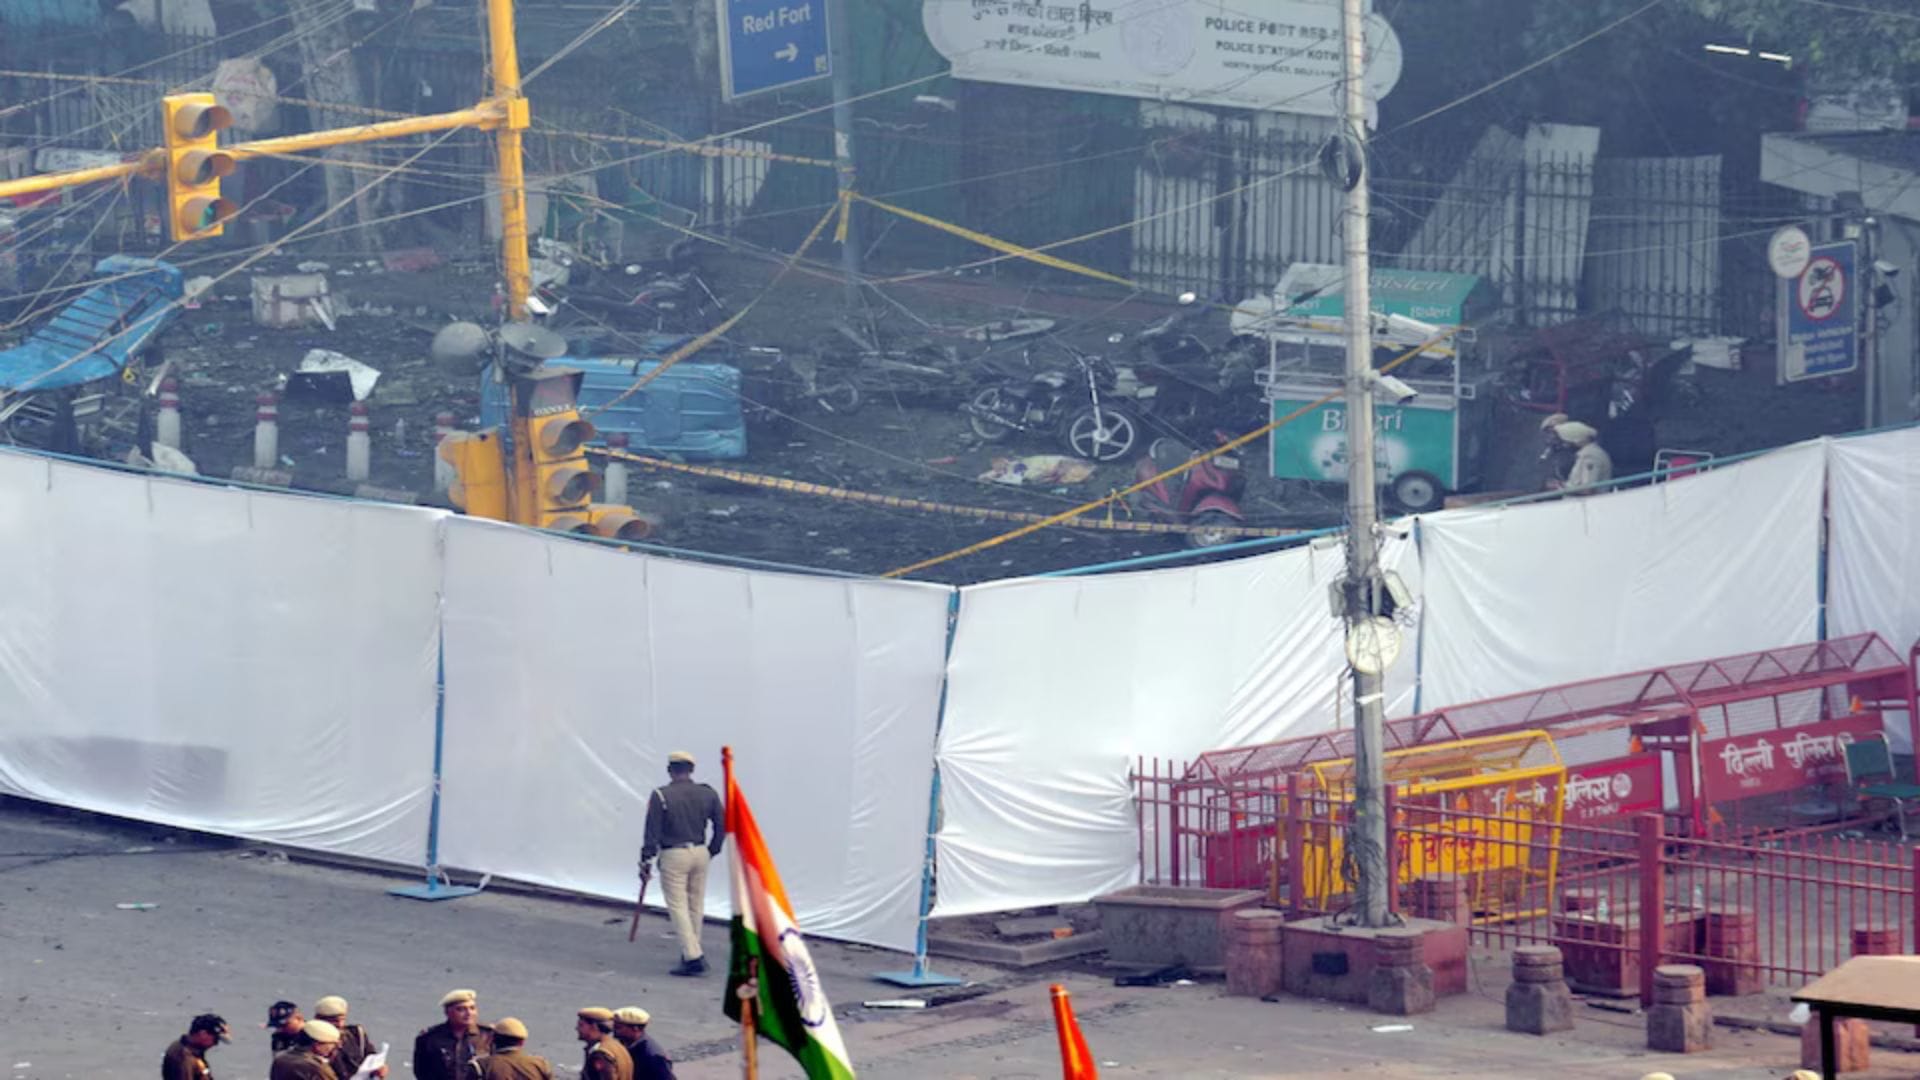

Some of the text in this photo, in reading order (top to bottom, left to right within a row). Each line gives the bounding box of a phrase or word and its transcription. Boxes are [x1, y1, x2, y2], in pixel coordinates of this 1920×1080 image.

[742, 2, 811, 34] Red Fort
[1205, 16, 1254, 34] POLICE
[1215, 40, 1255, 54] POLICE
[1307, 50, 1340, 61] KOTW
[1410, 305, 1453, 319] Bisleri
[1719, 732, 1836, 778] दिल्ली पुलिस
